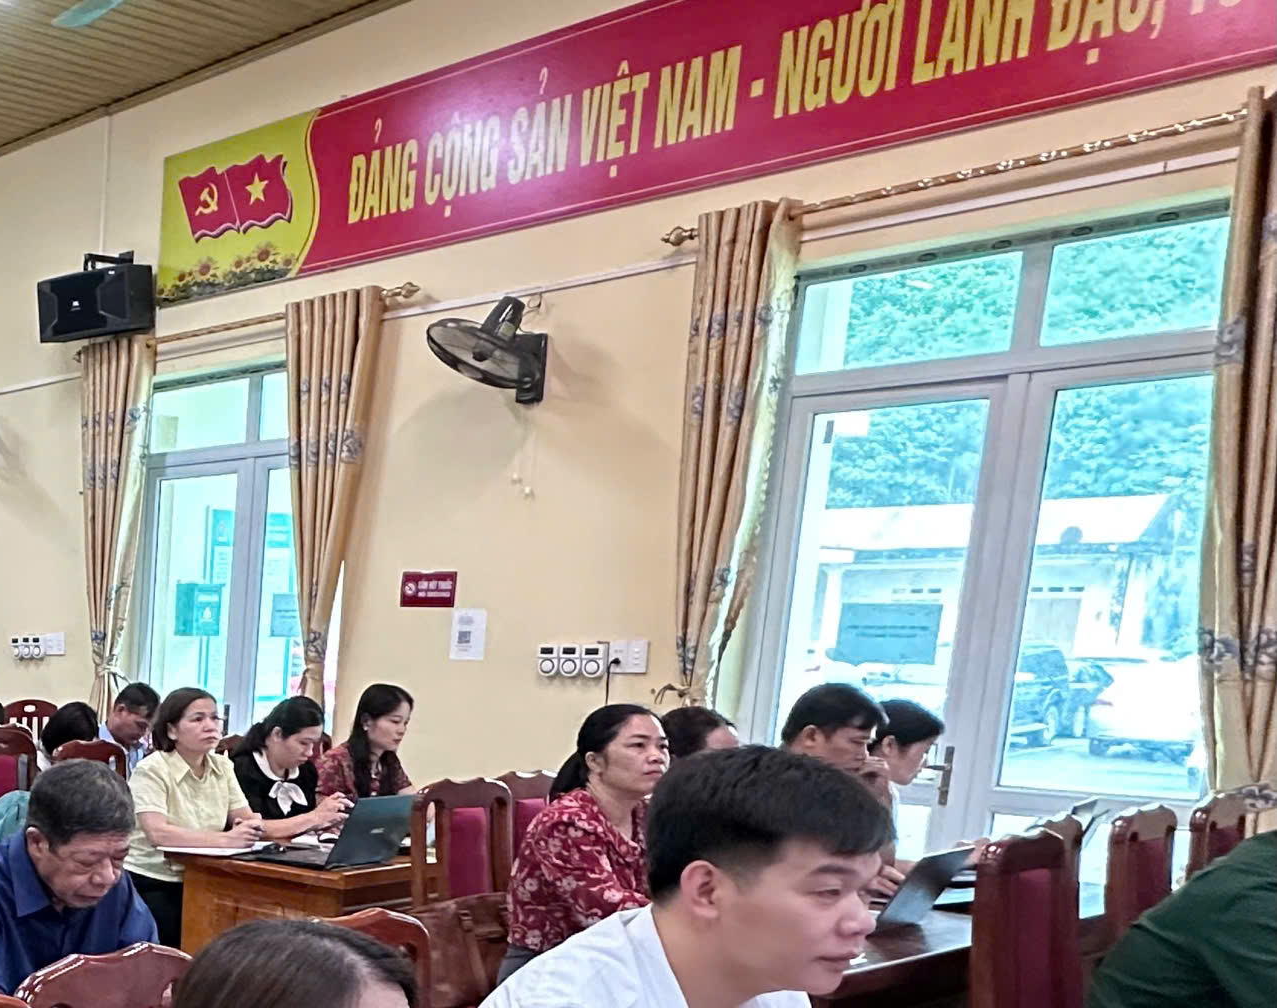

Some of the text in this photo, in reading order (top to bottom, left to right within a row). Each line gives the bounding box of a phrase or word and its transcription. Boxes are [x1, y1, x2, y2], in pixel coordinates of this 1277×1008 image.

[347, 117, 419, 224] ĐẢNG
[424, 112, 501, 217] CỘNG
[507, 67, 572, 184] SẢN
[580, 60, 651, 178] VIỆT
[654, 44, 742, 149] NAM
